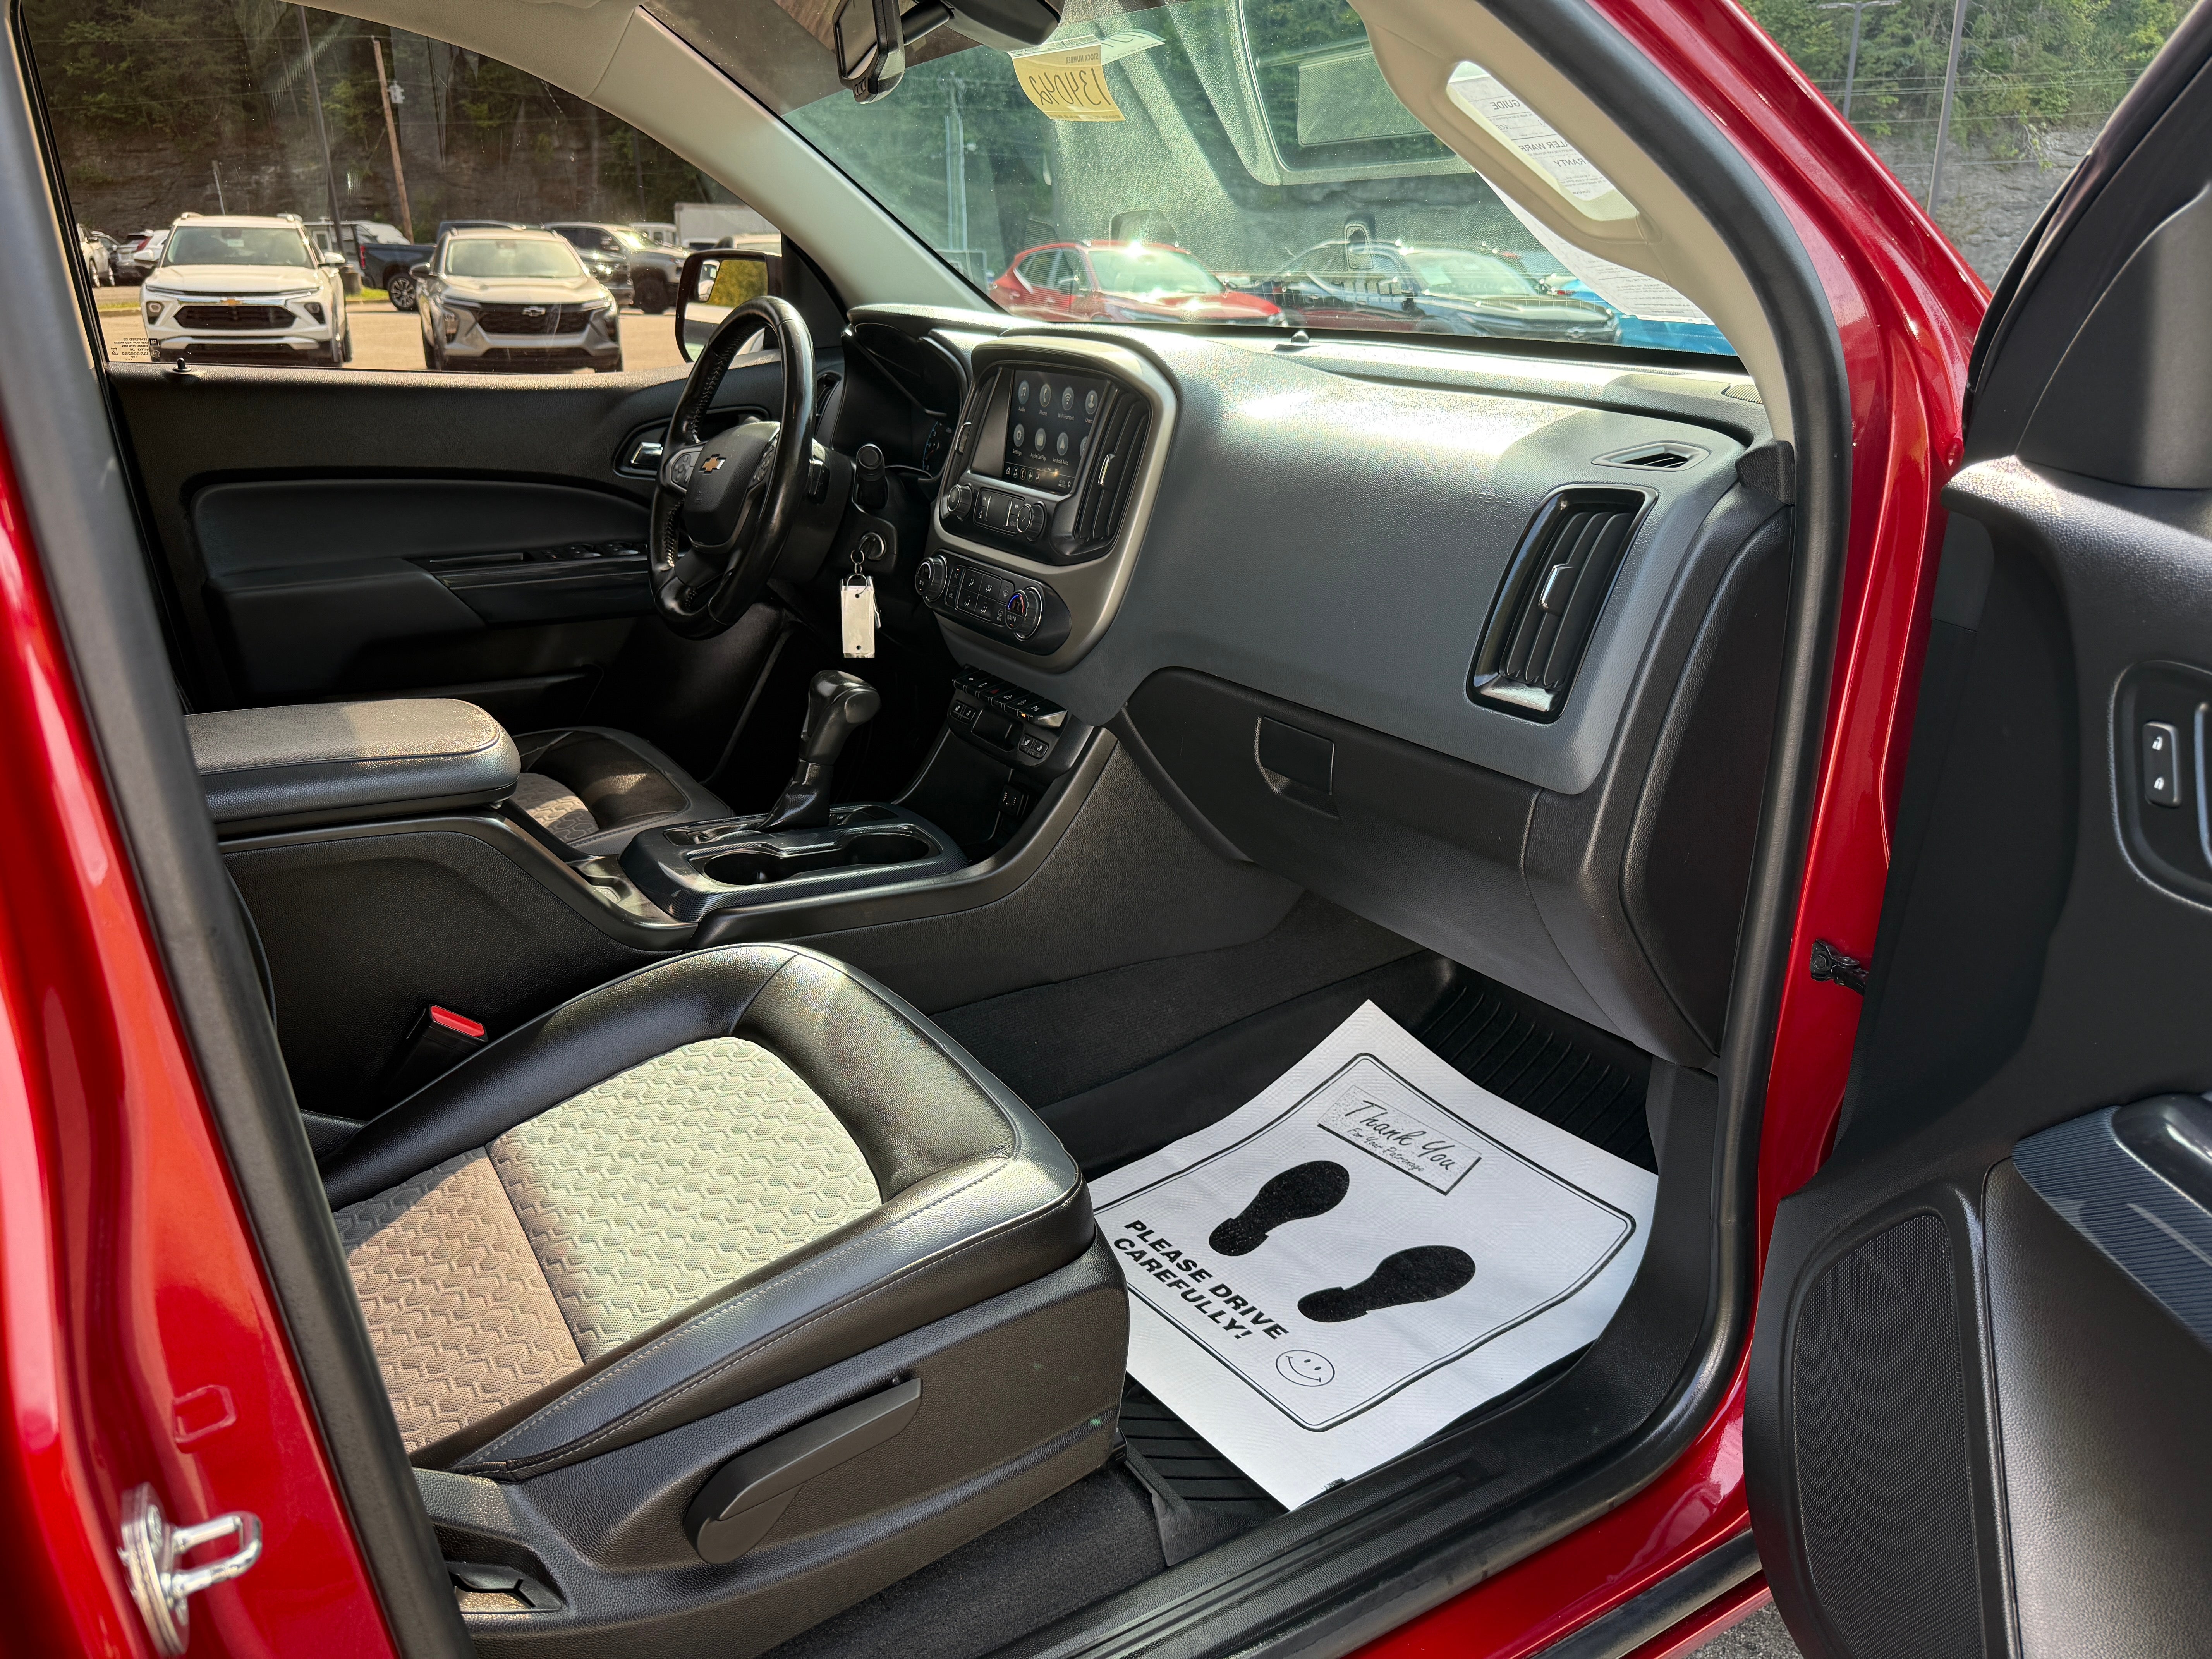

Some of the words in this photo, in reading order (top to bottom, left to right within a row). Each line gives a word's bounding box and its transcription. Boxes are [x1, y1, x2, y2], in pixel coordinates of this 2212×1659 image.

[1464, 491, 1515, 507] AIRBAG
[1345, 1100, 1427, 1146] Thank
[1417, 1140, 1457, 1171] You
[1347, 1127, 1363, 1139] For
[1366, 1136, 1383, 1149] Your
[1384, 1146, 1424, 1173] Patronage
[1113, 1238, 1254, 1340] CAREFULLY!
[1124, 1219, 1213, 1283] PLEASE
[1208, 1283, 1290, 1340] DRIVE
